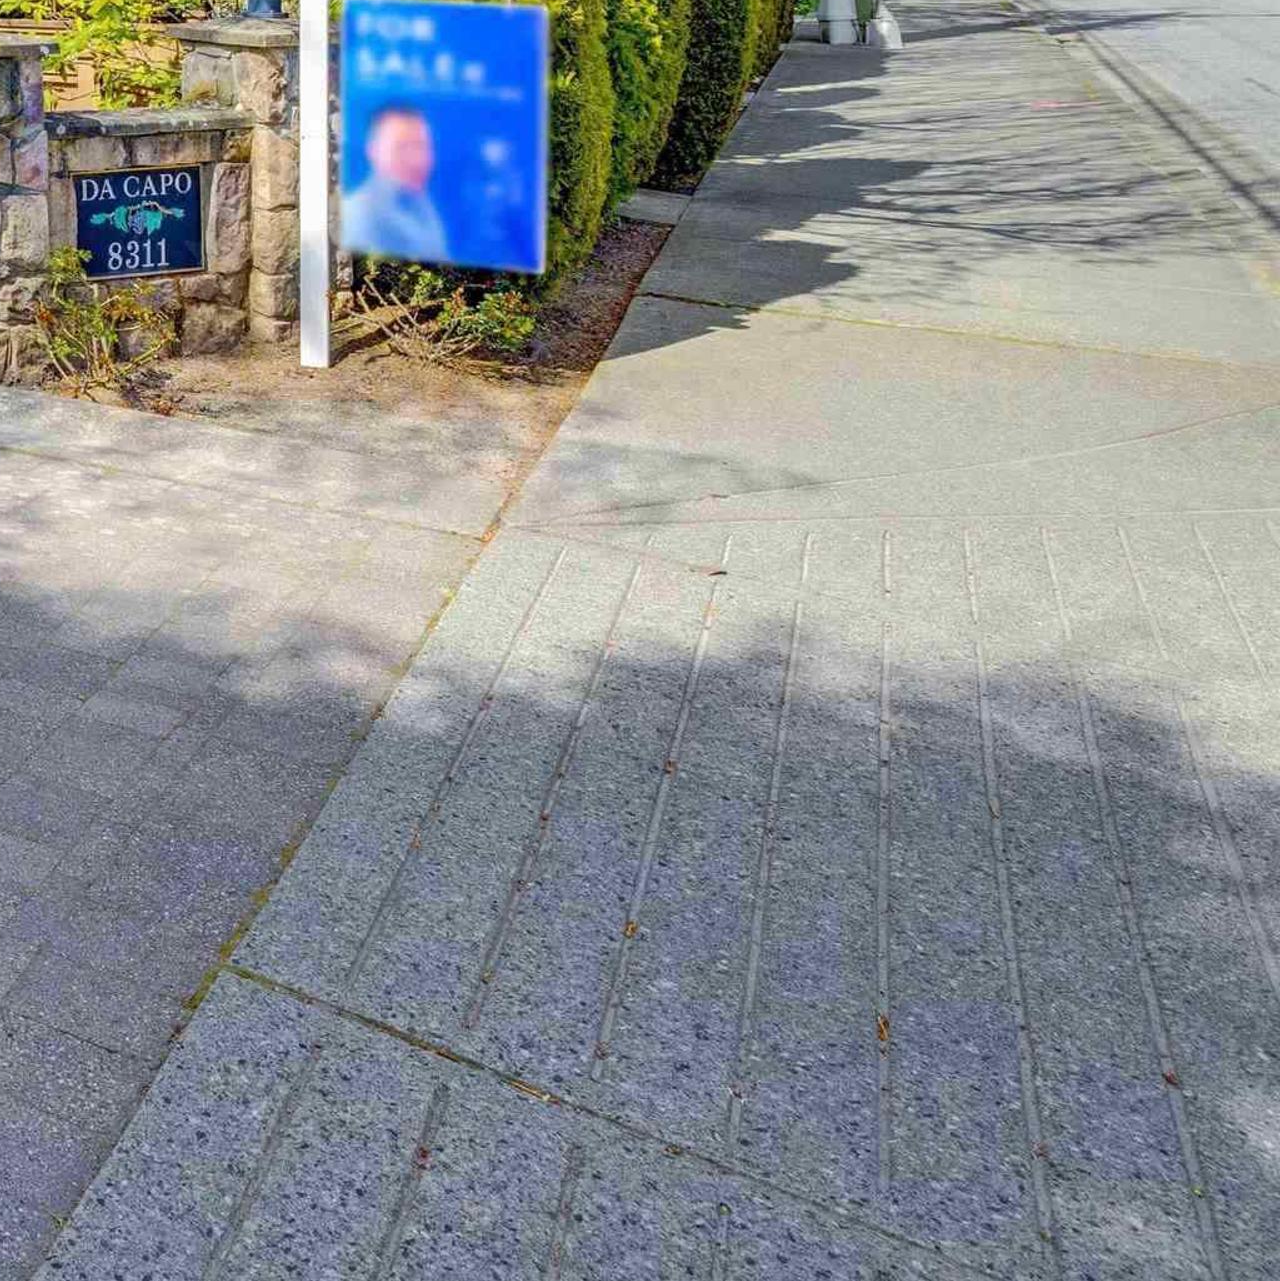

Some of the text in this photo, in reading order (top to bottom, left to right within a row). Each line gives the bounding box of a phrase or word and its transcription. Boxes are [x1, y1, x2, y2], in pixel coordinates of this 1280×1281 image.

[81, 172, 192, 201] DA CAPO
[108, 238, 170, 270] 8311
